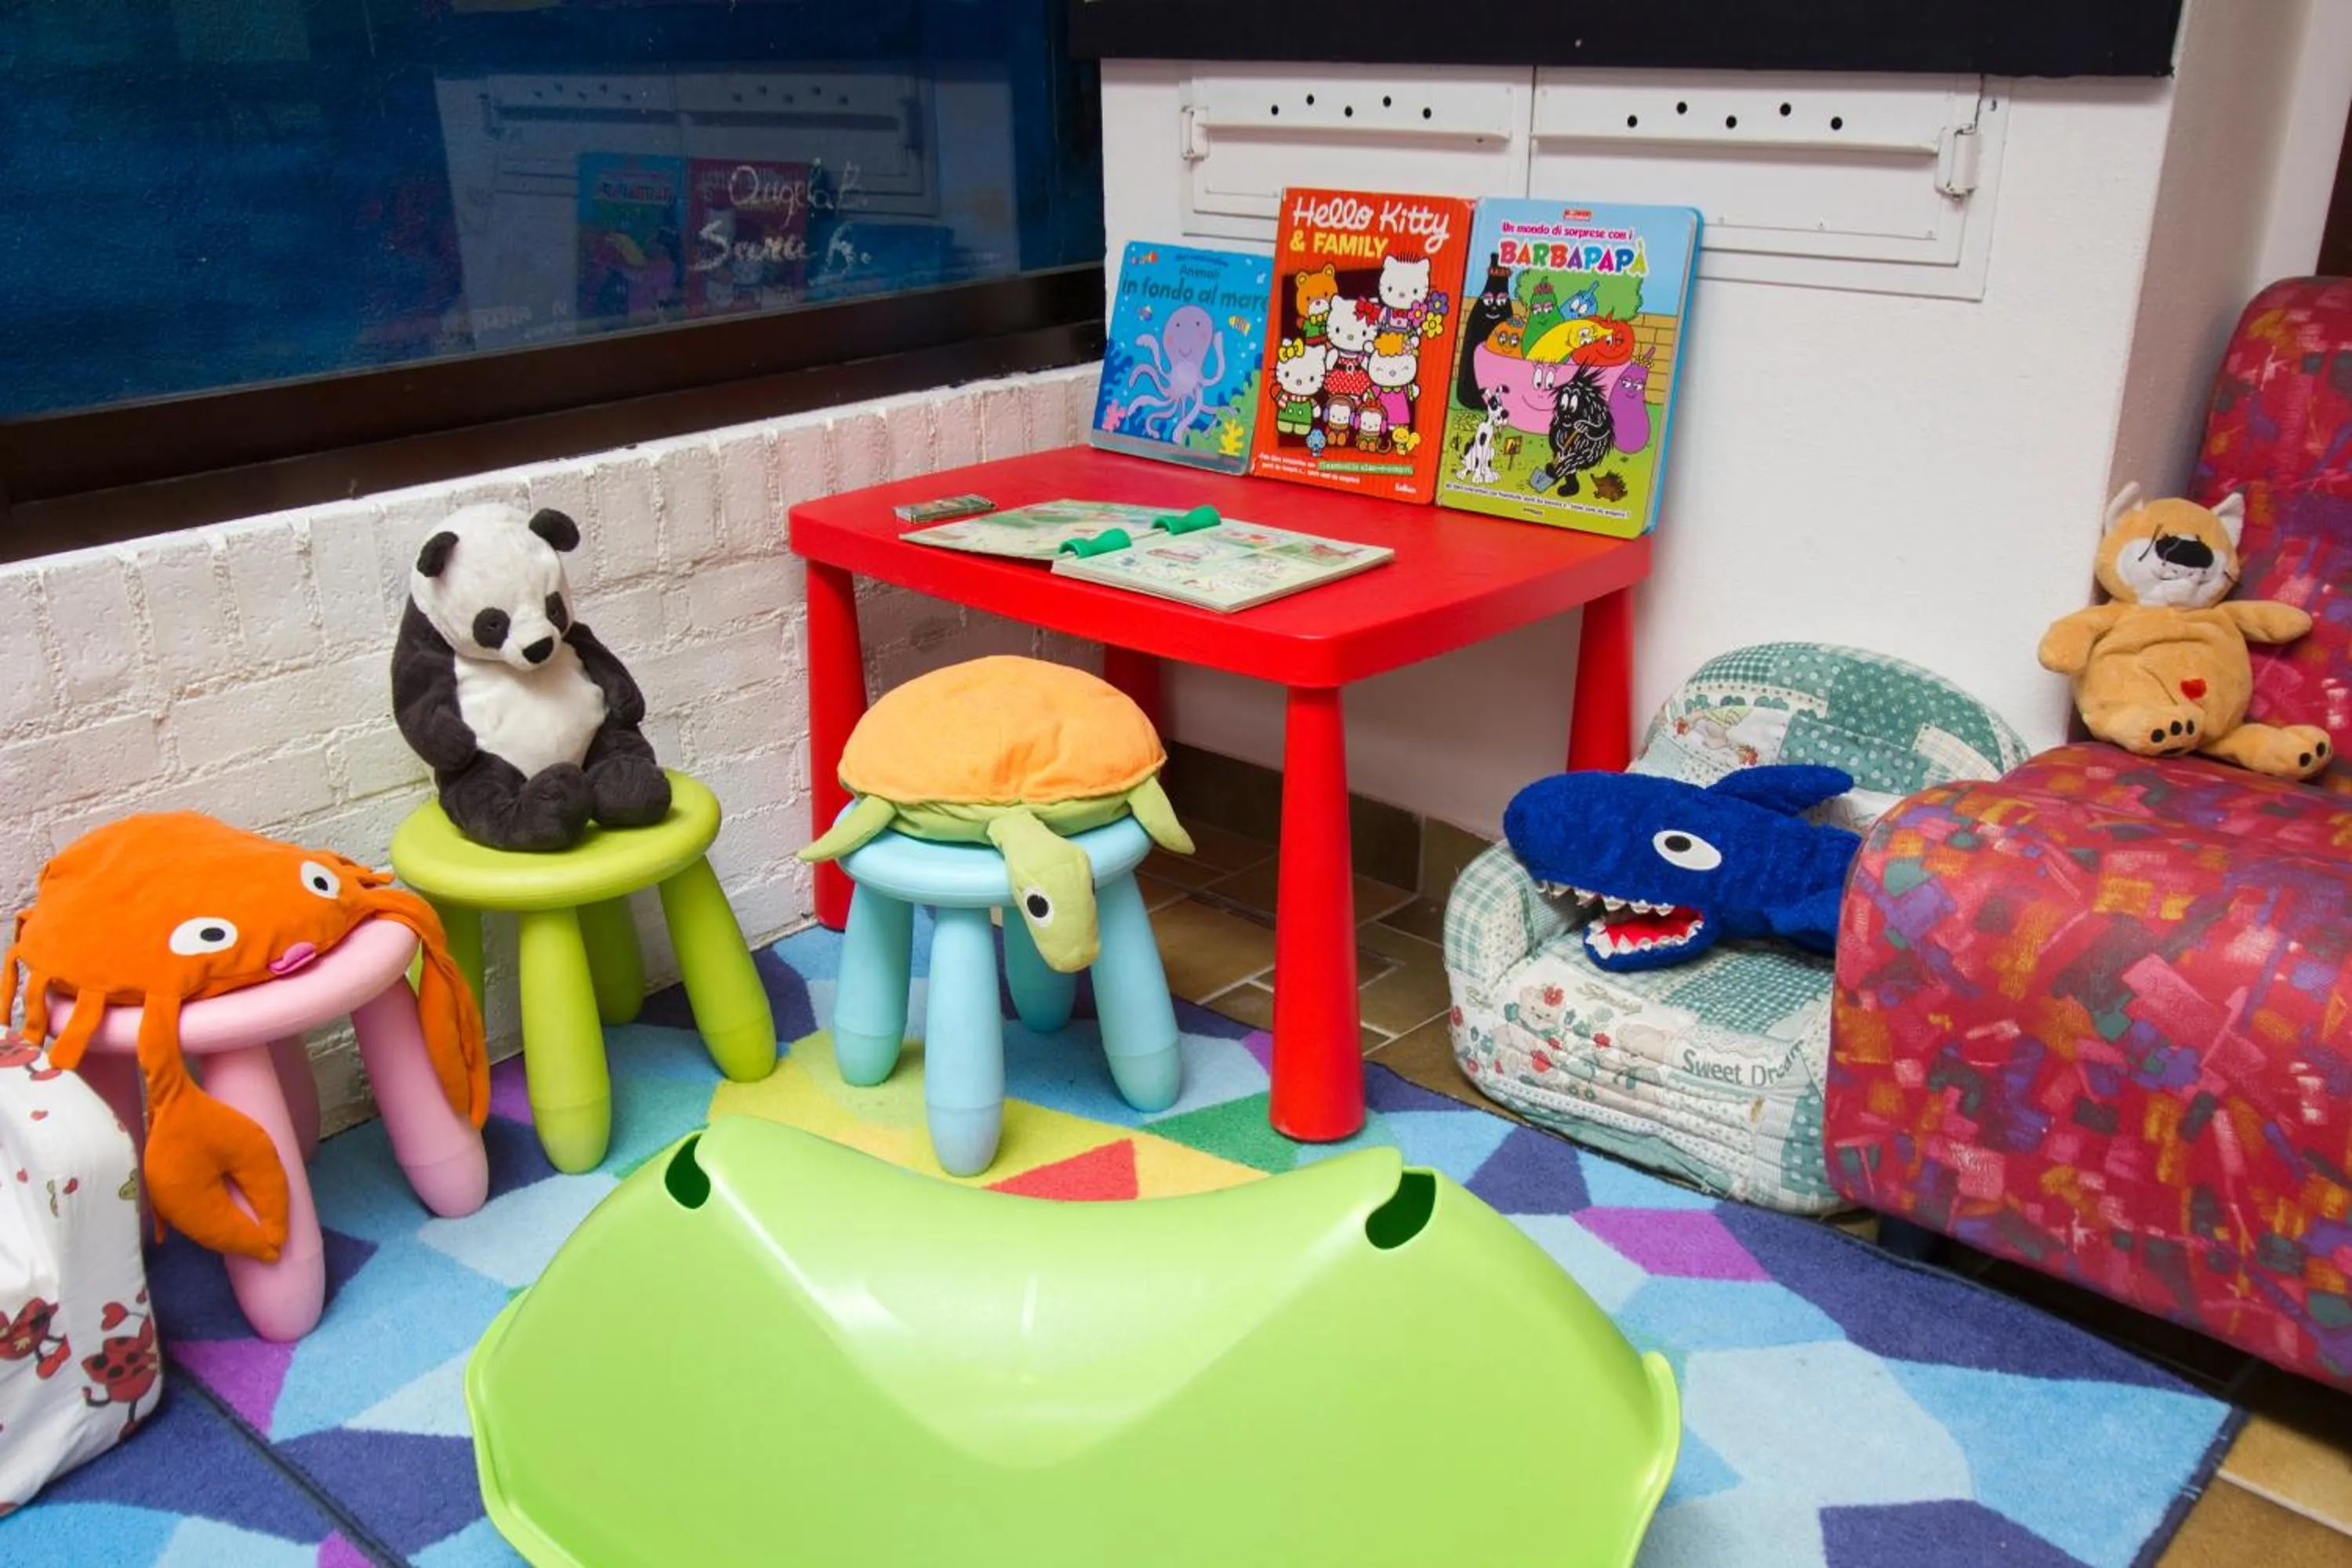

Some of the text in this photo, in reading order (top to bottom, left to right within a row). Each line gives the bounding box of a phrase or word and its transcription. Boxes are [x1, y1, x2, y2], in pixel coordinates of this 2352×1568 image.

[1293, 196, 1450, 254] Hello Kitty
[1502, 222, 1515, 232] Un
[1517, 224, 1549, 234] mondo
[1552, 224, 1563, 235] di
[1565, 228, 1606, 239] sorprese
[1608, 230, 1626, 240] con
[1290, 229, 1388, 259] & FAMILY
[1499, 238, 1648, 274] BARBAPAPÀ
[1142, 276, 1193, 303] fondo
[1198, 285, 1218, 304] al
[1682, 1048, 1742, 1086] Sweet
